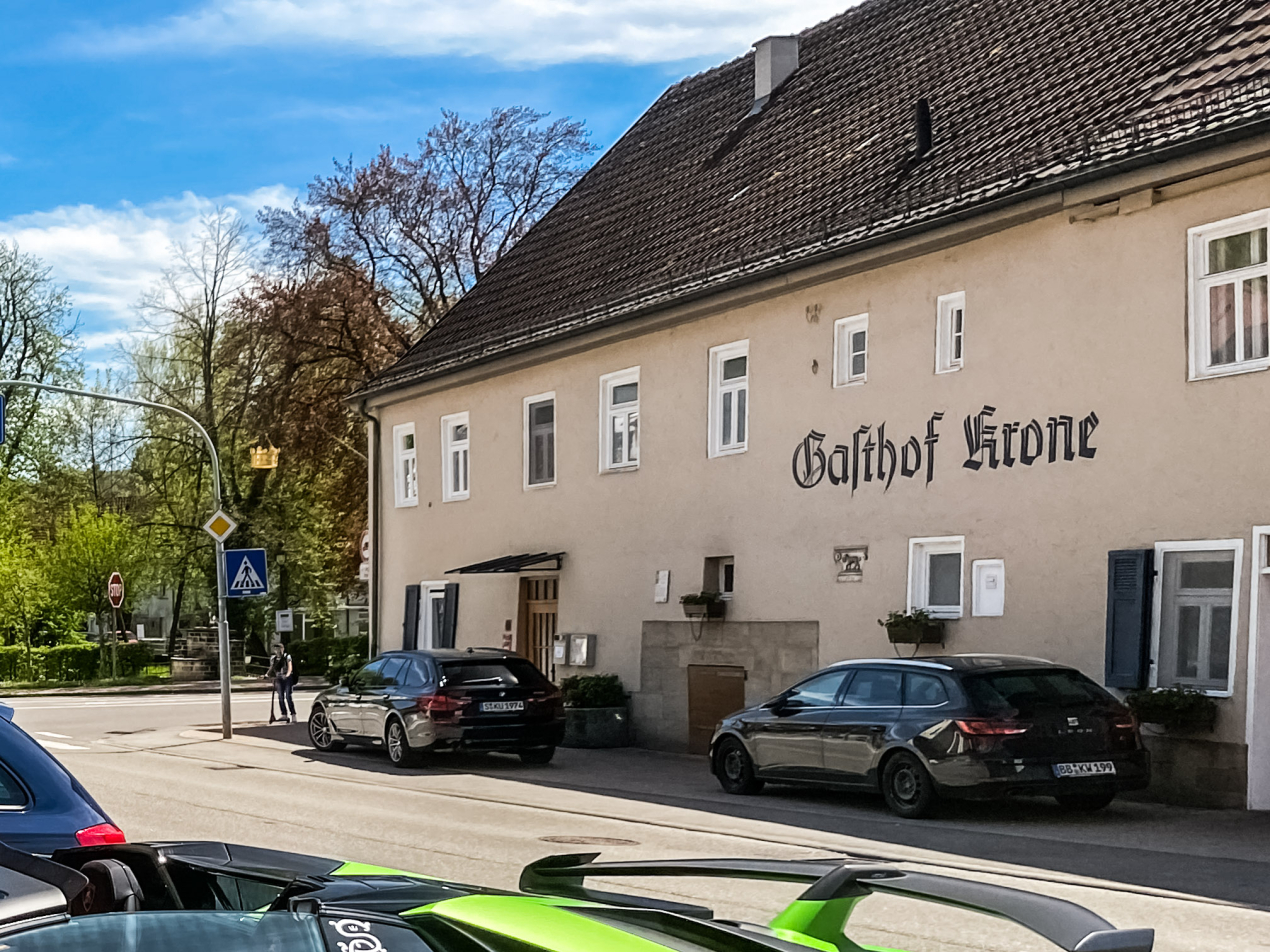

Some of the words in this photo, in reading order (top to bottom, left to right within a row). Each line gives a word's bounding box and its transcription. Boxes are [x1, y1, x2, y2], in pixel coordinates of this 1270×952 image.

[962, 405, 1099, 471] Krone
[110, 583, 121, 597] STOP
[1094, 762, 1113, 772] 199
